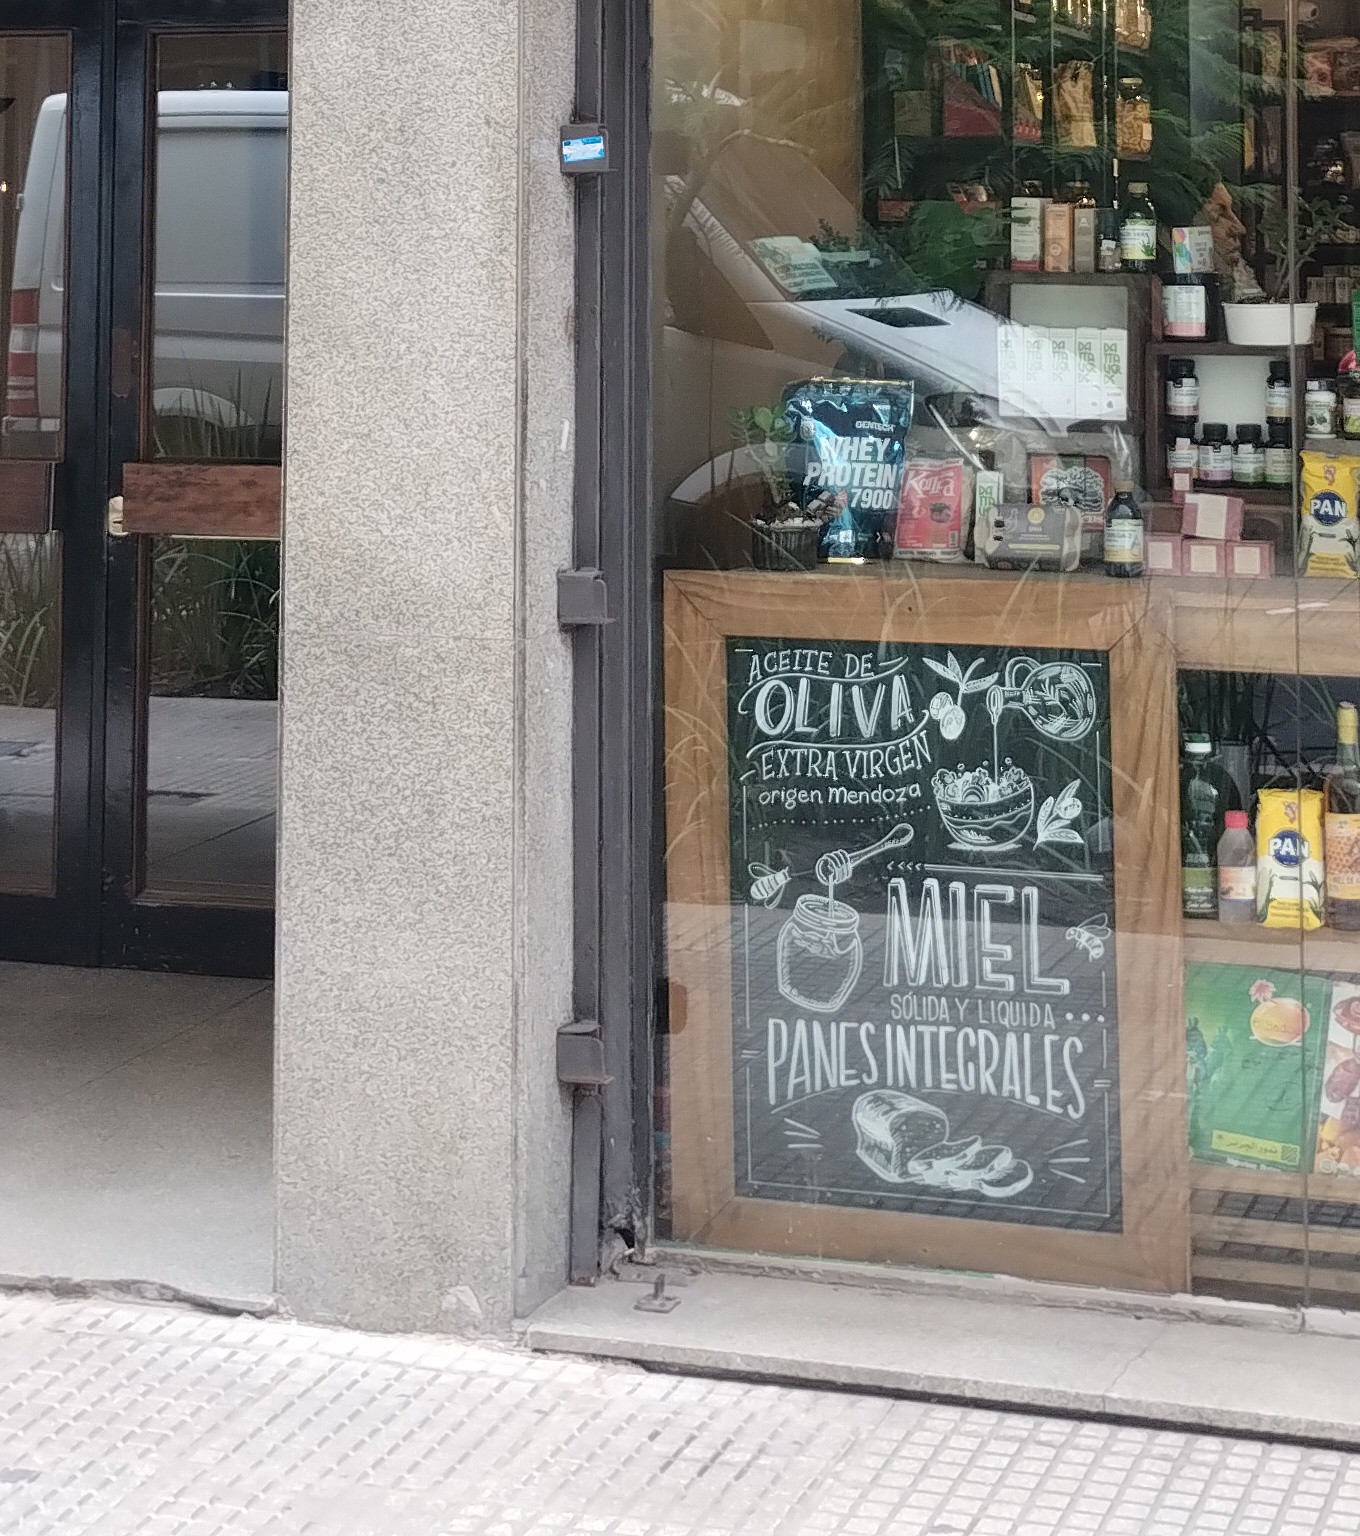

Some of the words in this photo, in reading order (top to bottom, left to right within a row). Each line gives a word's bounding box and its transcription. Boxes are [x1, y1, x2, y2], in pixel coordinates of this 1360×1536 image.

[820, 436, 891, 462] WHEY
[802, 461, 898, 489] PROTEIN
[850, 488, 894, 510] 7900
[1310, 499, 1347, 518] PAN
[749, 650, 833, 685] ACEITE
[844, 652, 874, 678] DE
[755, 675, 915, 738] OLIVA
[761, 746, 839, 782] EXTRA
[843, 730, 934, 779] VIRGEN
[759, 787, 823, 810] origen
[1269, 837, 1310, 859] PAN
[883, 877, 1070, 995] MIEL
[890, 991, 951, 1023] SÓLIDA
[955, 997, 970, 1023] Y
[978, 999, 1055, 1030] LIQUIDA
[767, 1018, 877, 1106] PANES
[885, 1024, 1085, 1120] INTEGRALES
